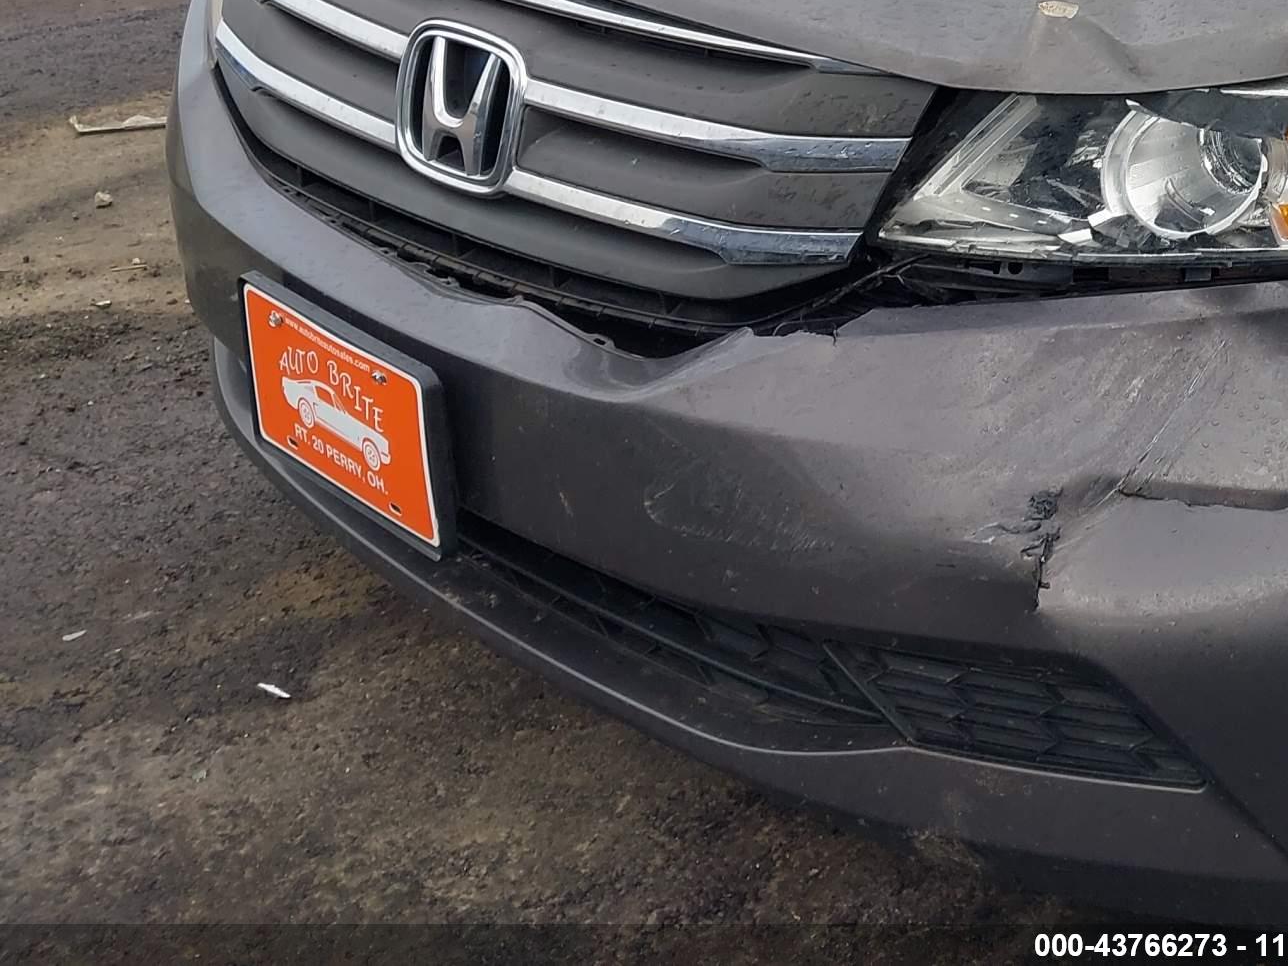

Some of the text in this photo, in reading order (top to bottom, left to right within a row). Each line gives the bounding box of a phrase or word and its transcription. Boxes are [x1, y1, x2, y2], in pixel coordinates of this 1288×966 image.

[279, 345, 385, 434] AUTO BRITE
[293, 422, 310, 447] RT.
[311, 434, 325, 456] 20
[366, 469, 389, 496] OH.
